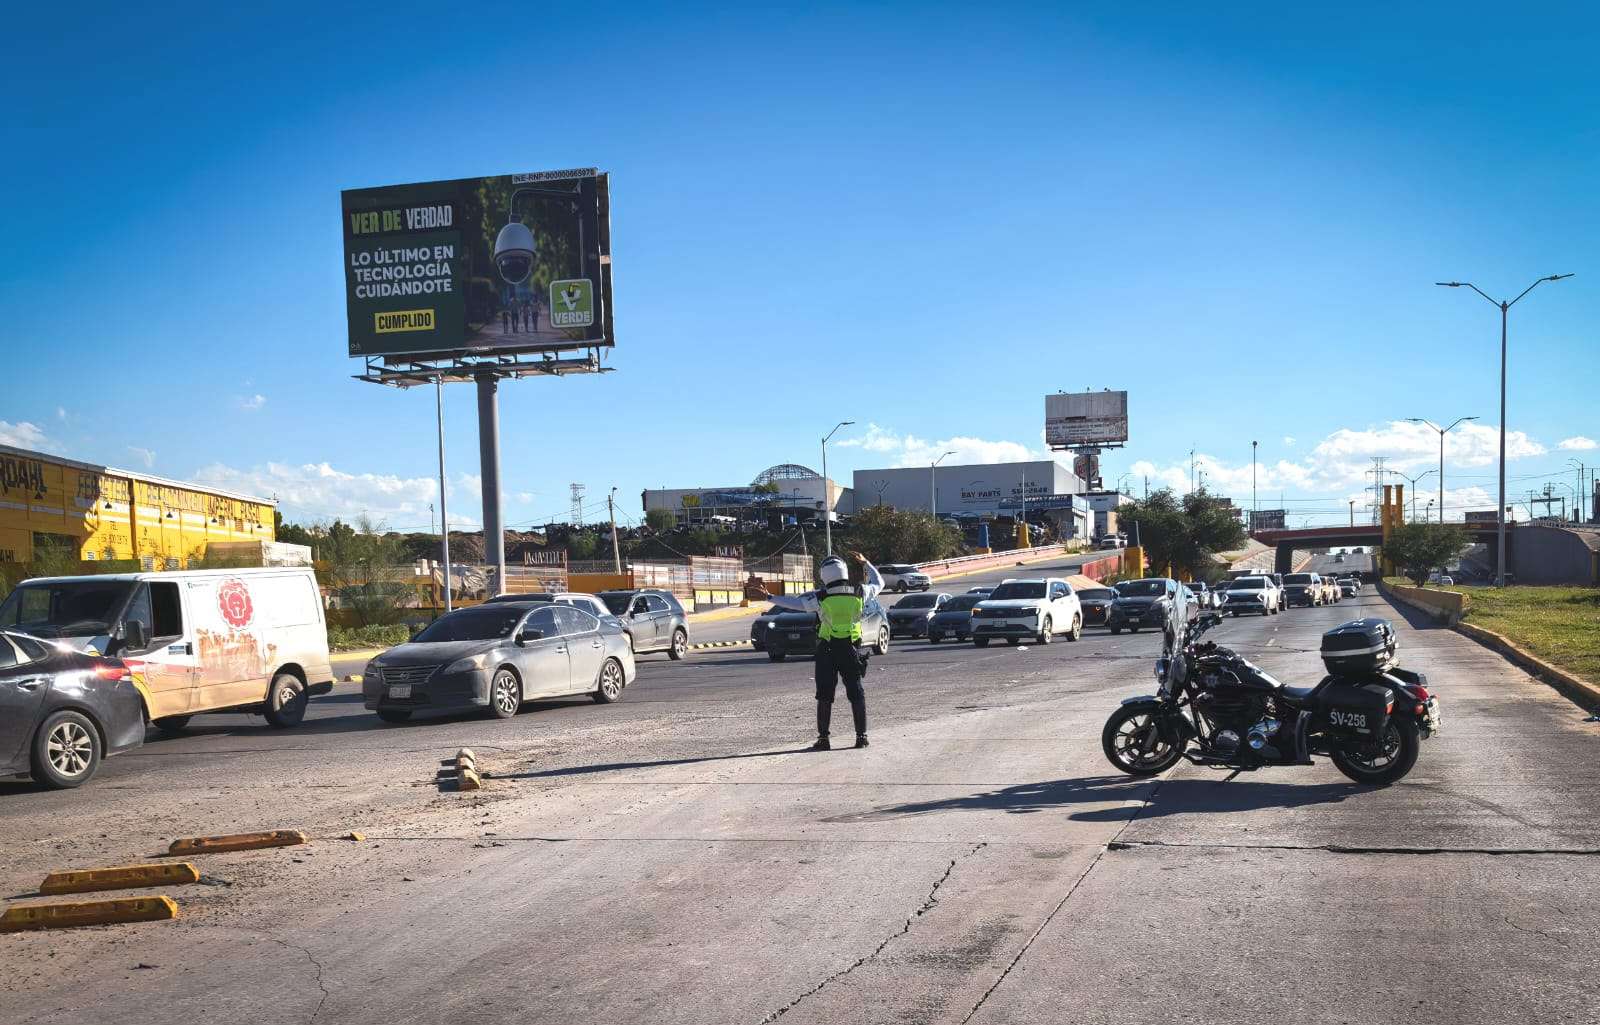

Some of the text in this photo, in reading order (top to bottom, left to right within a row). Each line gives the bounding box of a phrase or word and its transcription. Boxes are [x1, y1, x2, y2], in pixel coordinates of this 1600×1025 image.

[351, 205, 453, 234] VER DE VERDAD
[351, 245, 454, 266] LO ÚLTIMO EN
[355, 260, 452, 282] TECNOLOGÍA
[355, 279, 452, 299] CUIDÁNDOTE
[378, 312, 431, 329] CUMPLIDO
[554, 311, 591, 324] VERDE
[1330, 710, 1366, 728] SV-258
